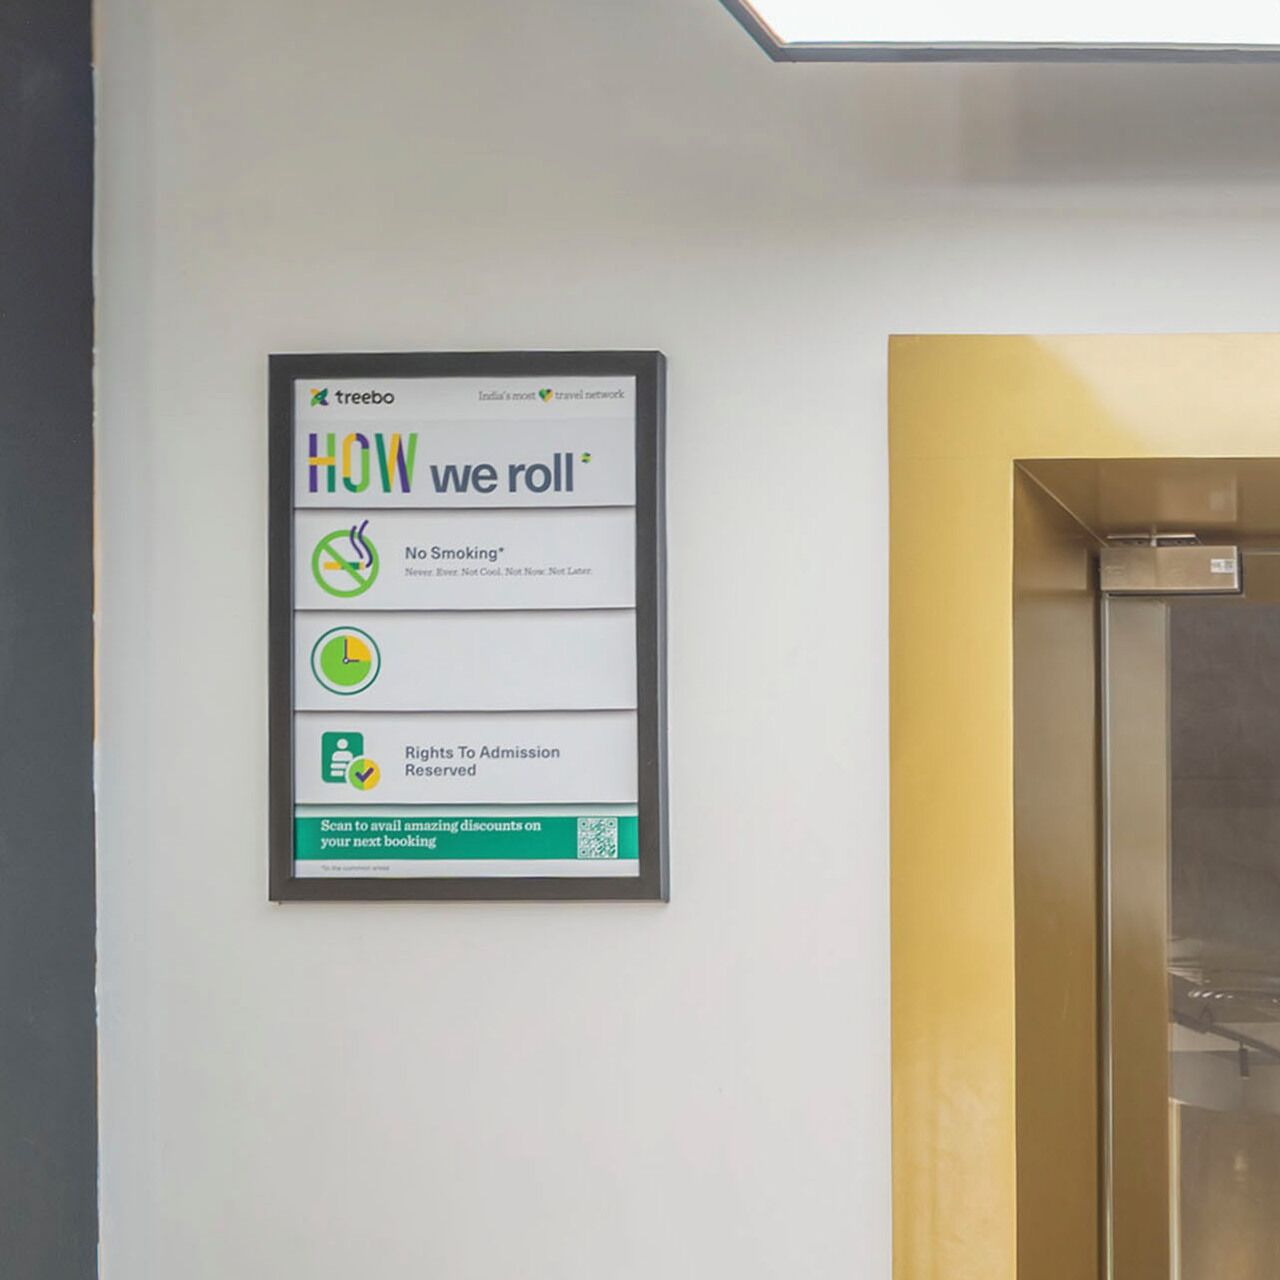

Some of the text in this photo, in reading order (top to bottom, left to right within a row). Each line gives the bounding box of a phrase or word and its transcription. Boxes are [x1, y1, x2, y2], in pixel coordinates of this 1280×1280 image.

[335, 390, 395, 405] treebo
[478, 389, 624, 400] India's most travel network
[307, 433, 573, 493] HOW we roll
[406, 547, 427, 559] No
[406, 746, 560, 762] Rights To Admission
[405, 764, 476, 776] Reserved
[321, 819, 541, 833] Scan to avail amazing discounts on
[321, 836, 436, 849] your next booking
